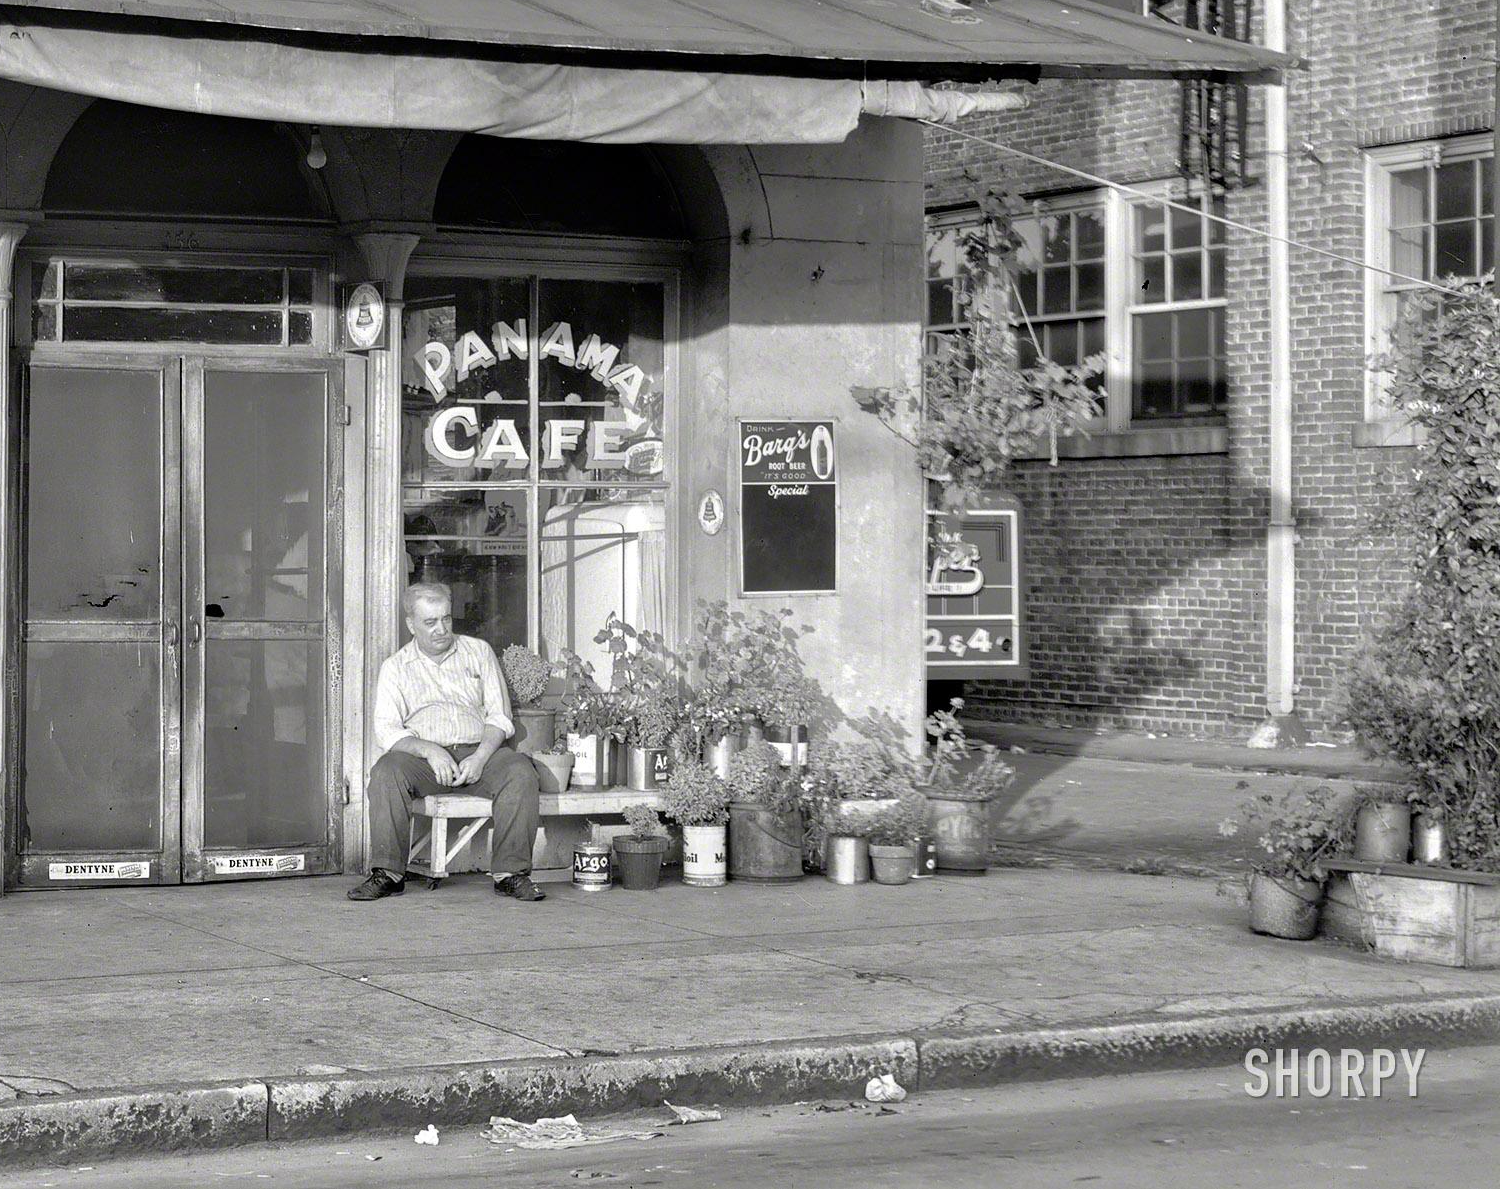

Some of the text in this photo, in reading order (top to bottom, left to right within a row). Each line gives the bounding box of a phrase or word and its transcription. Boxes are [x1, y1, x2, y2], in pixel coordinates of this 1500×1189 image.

[413, 318, 647, 406] PANAMA
[425, 406, 628, 469] CAFE
[743, 430, 810, 466] Barq's
[768, 462, 806, 470] ROOT BEER
[768, 484, 808, 499] Special
[65, 865, 115, 874] DENTYNE
[229, 858, 274, 868] DENTYNE
[574, 853, 608, 872] Argo
